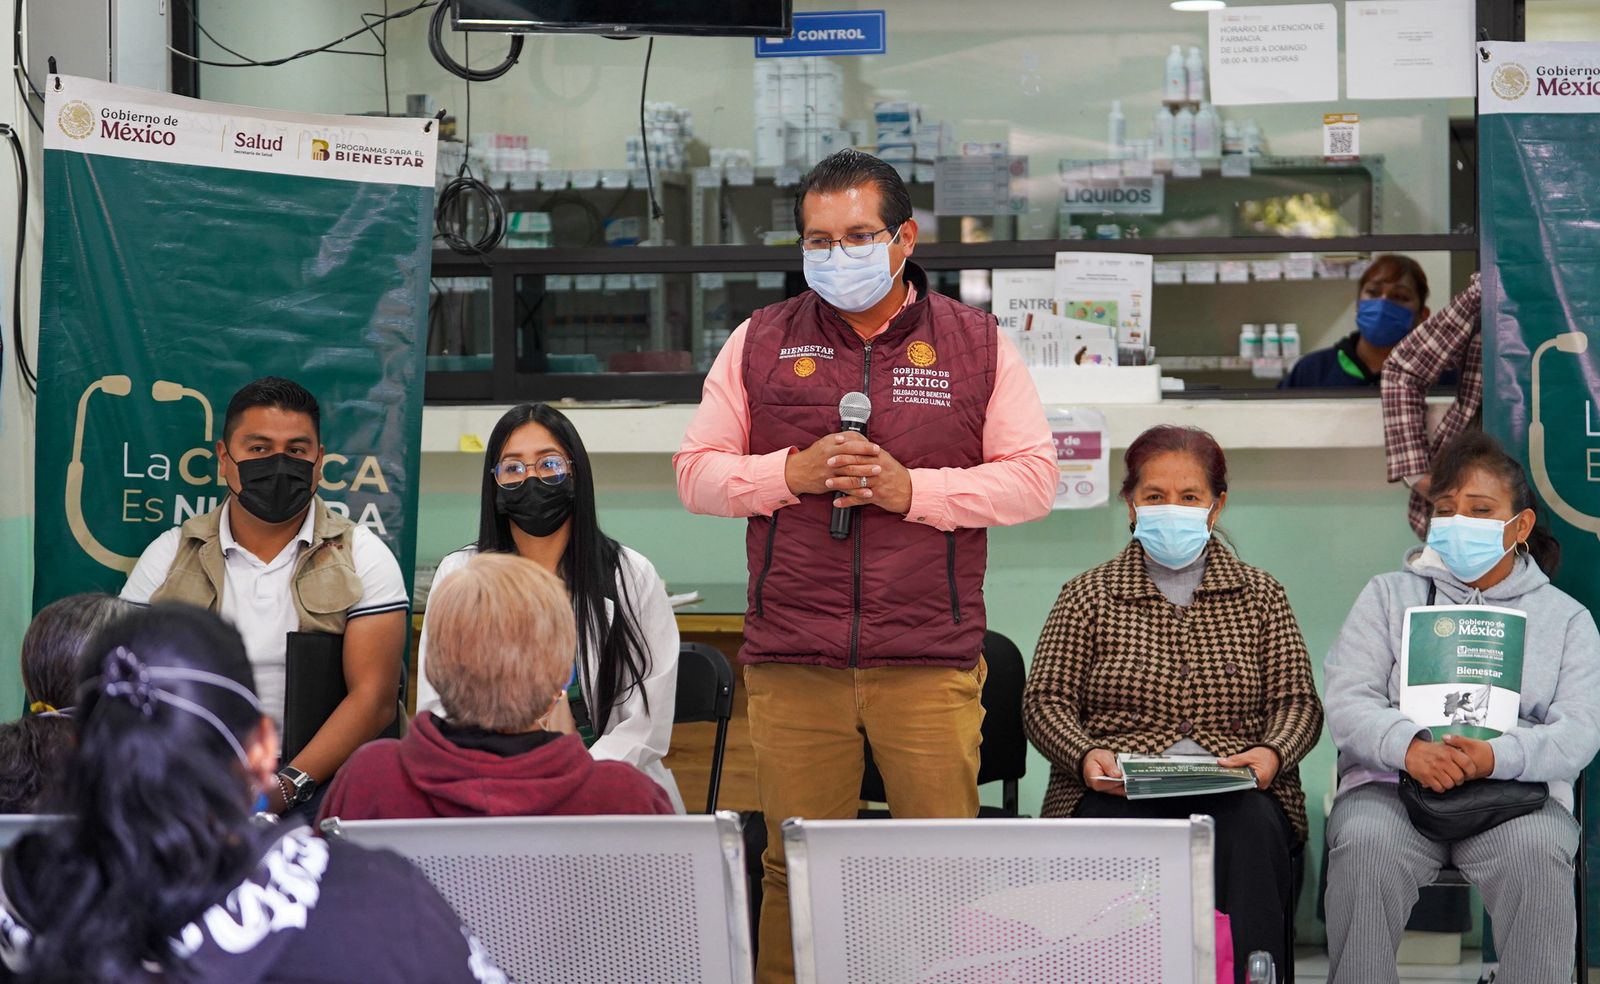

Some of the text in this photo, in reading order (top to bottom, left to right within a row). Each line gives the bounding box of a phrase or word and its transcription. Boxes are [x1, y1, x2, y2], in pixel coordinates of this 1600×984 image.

[798, 29, 866, 41] CONTROL
[1220, 25, 1257, 33] HORARIO
[1258, 24, 1270, 32] DE
[1233, 45, 1260, 53] LUNES
[1268, 44, 1307, 52] DOMINGO
[1271, 54, 1299, 62] HORAS
[101, 108, 160, 124] Gobierno
[163, 115, 178, 126] de
[100, 119, 176, 146] México
[234, 132, 283, 151] Salud
[335, 143, 387, 154] PROGRAMAS
[390, 148, 412, 156] PARA
[335, 151, 424, 167] BIENESTAR
[1065, 188, 1151, 203] LIQUIDOS
[780, 345, 835, 355] BIENESTAR
[893, 367, 949, 378] GOBIERNO DE
[893, 374, 949, 389] MÉXICO
[926, 390, 951, 399] BIENESTAR
[1063, 435, 1081, 446] de
[123, 442, 171, 481] La
[123, 489, 164, 523] Es
[1459, 624, 1505, 638] México
[1456, 666, 1503, 678] Bienestar
